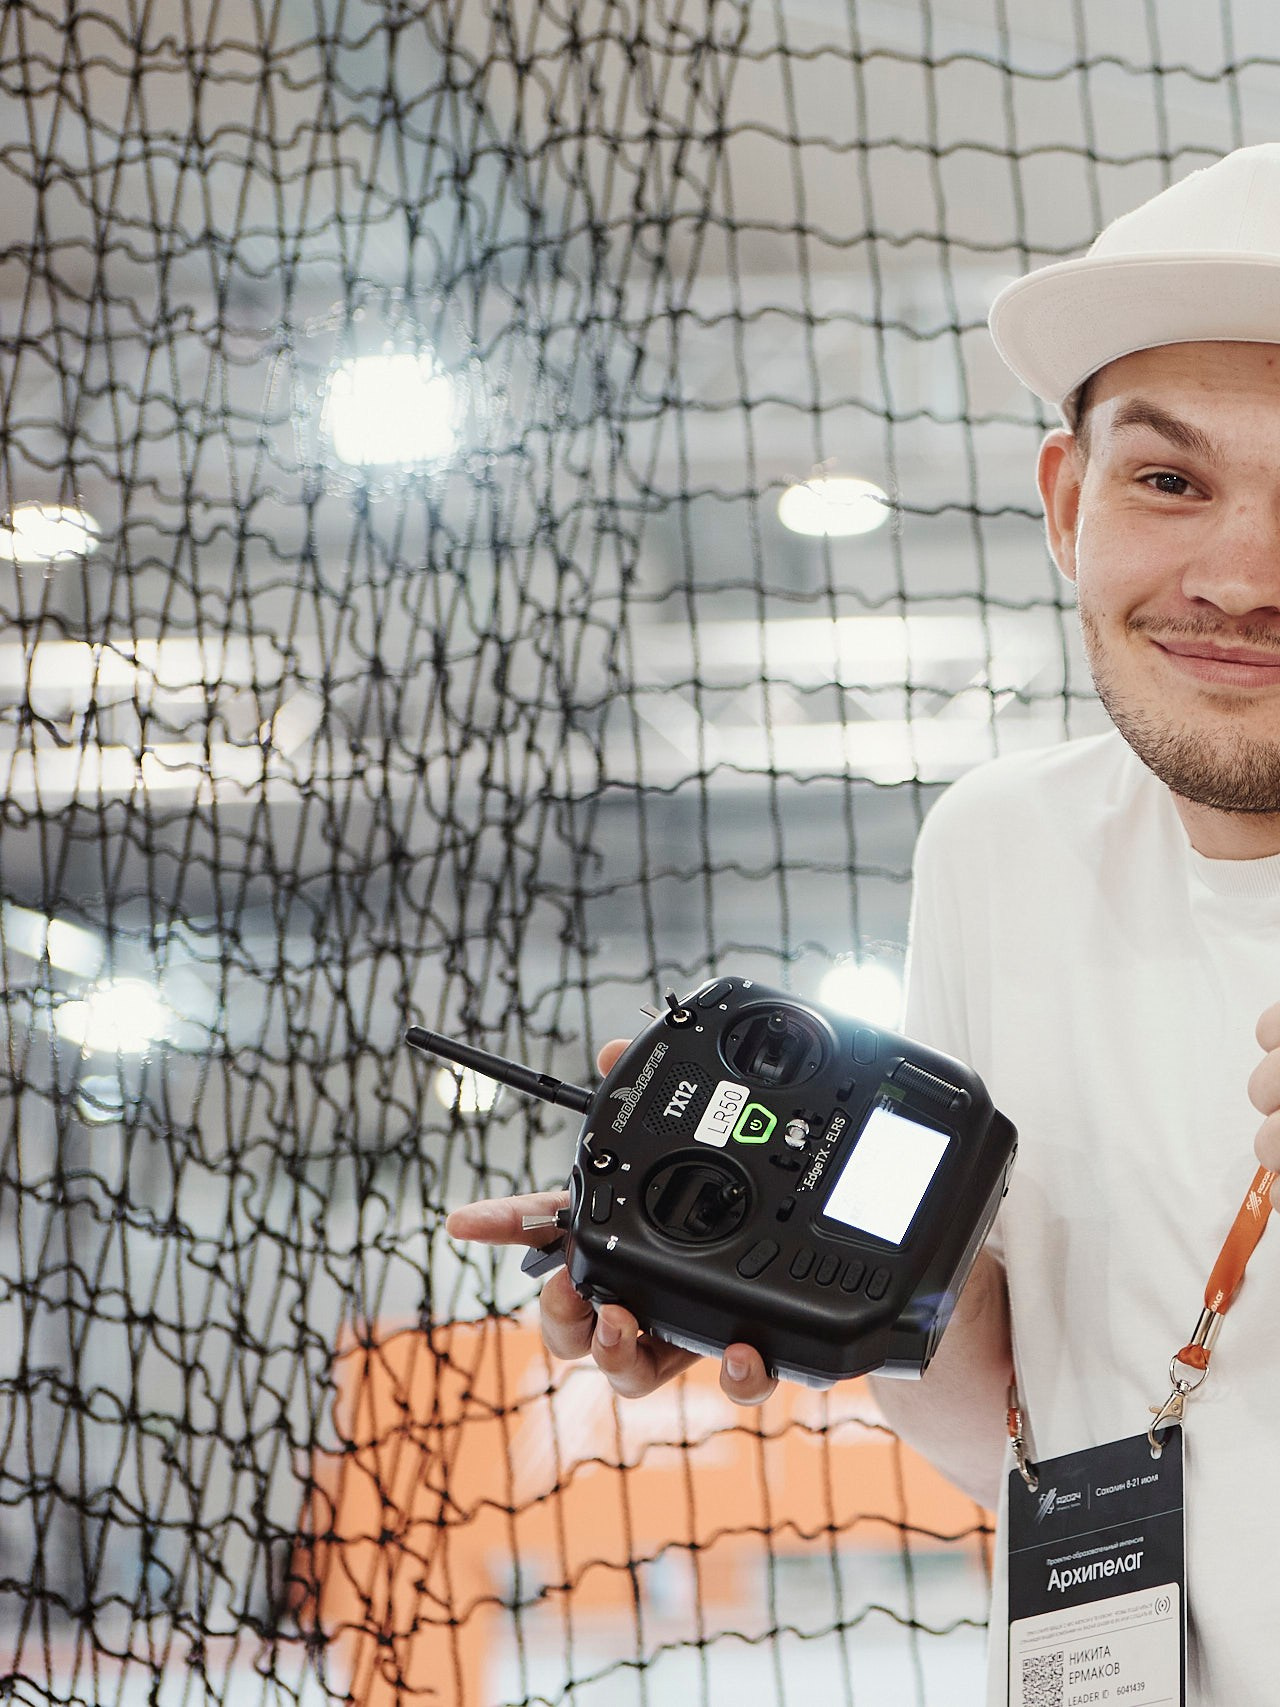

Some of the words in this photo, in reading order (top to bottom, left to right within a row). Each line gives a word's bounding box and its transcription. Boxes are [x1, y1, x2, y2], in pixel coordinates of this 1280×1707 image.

[719, 1003, 728, 1011] D
[695, 1025, 704, 1033] C
[663, 1081, 698, 1118] TX12
[708, 1090, 743, 1134] LR50
[804, 1148, 830, 1188] EdgeTX
[826, 1116, 846, 1143] ELRS
[617, 1197, 626, 1206] A
[606, 1235, 619, 1251] S1
[1095, 1483, 1126, 1497] Сахалин
[1126, 1477, 1140, 1489] 8-21
[1140, 1474, 1159, 1485] июля
[1047, 1552, 1144, 1592] Архипелаг
[1069, 1645, 1112, 1666] НИКИТА
[1068, 1662, 1121, 1685] ЕРМАКОВ
[1068, 1691, 1099, 1707] LEADER
[1116, 1682, 1146, 1696] 6041439
